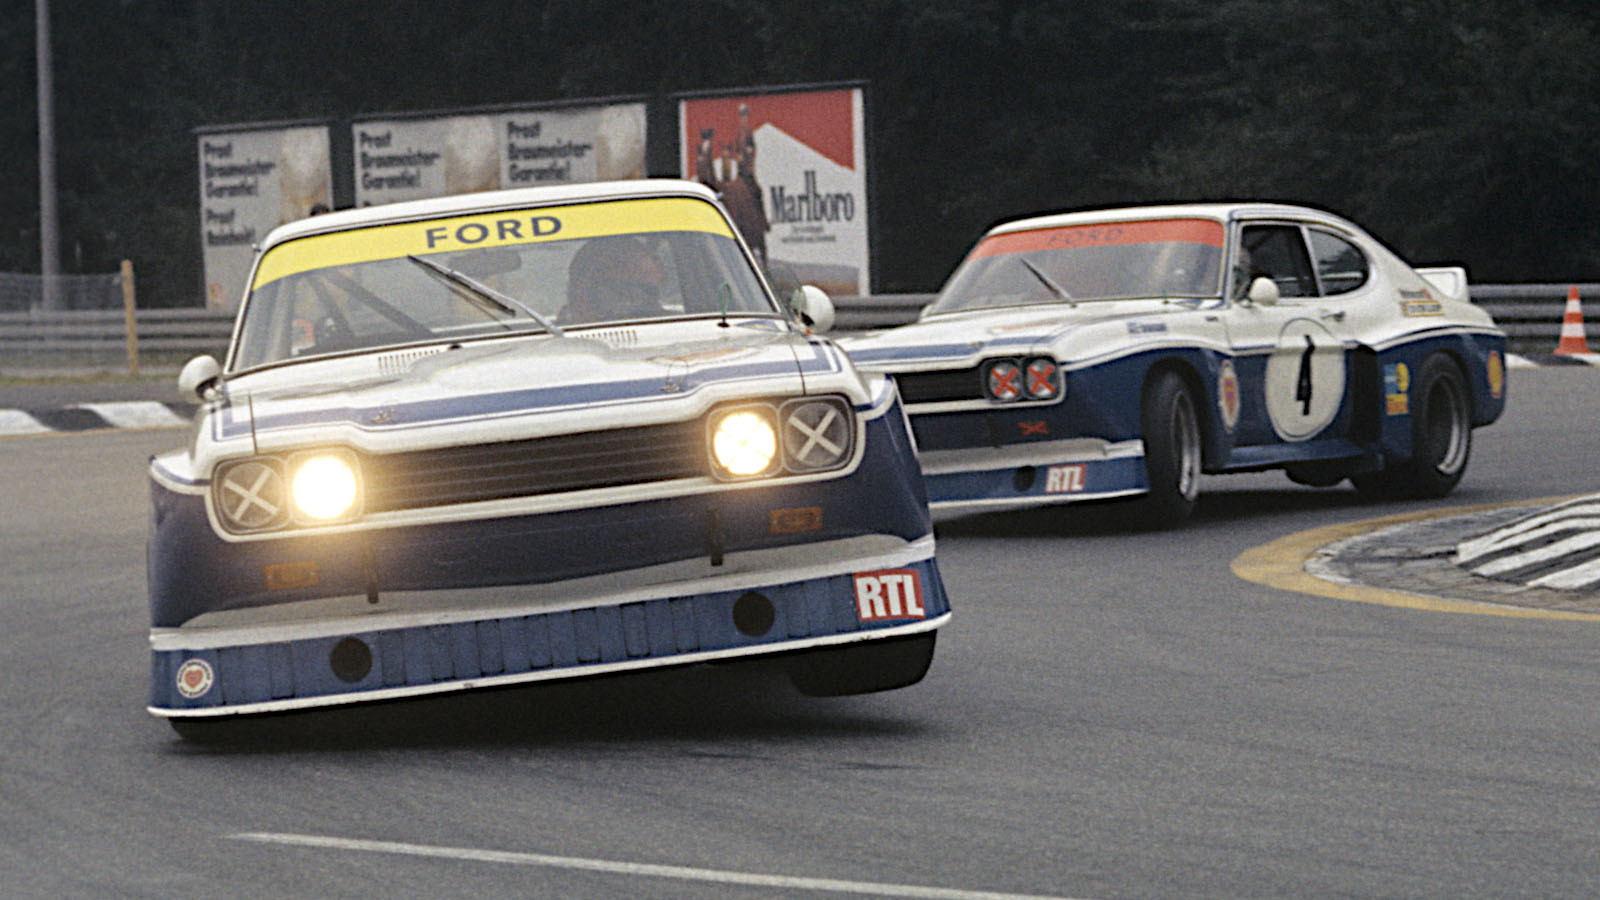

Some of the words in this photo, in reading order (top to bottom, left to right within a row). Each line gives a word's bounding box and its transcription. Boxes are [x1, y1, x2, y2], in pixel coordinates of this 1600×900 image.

[769, 170, 854, 224] Marlboro
[426, 216, 562, 249] FORD
[1048, 226, 1124, 246] FORD
[1045, 466, 1083, 492] RTL
[855, 574, 925, 619] RTL
